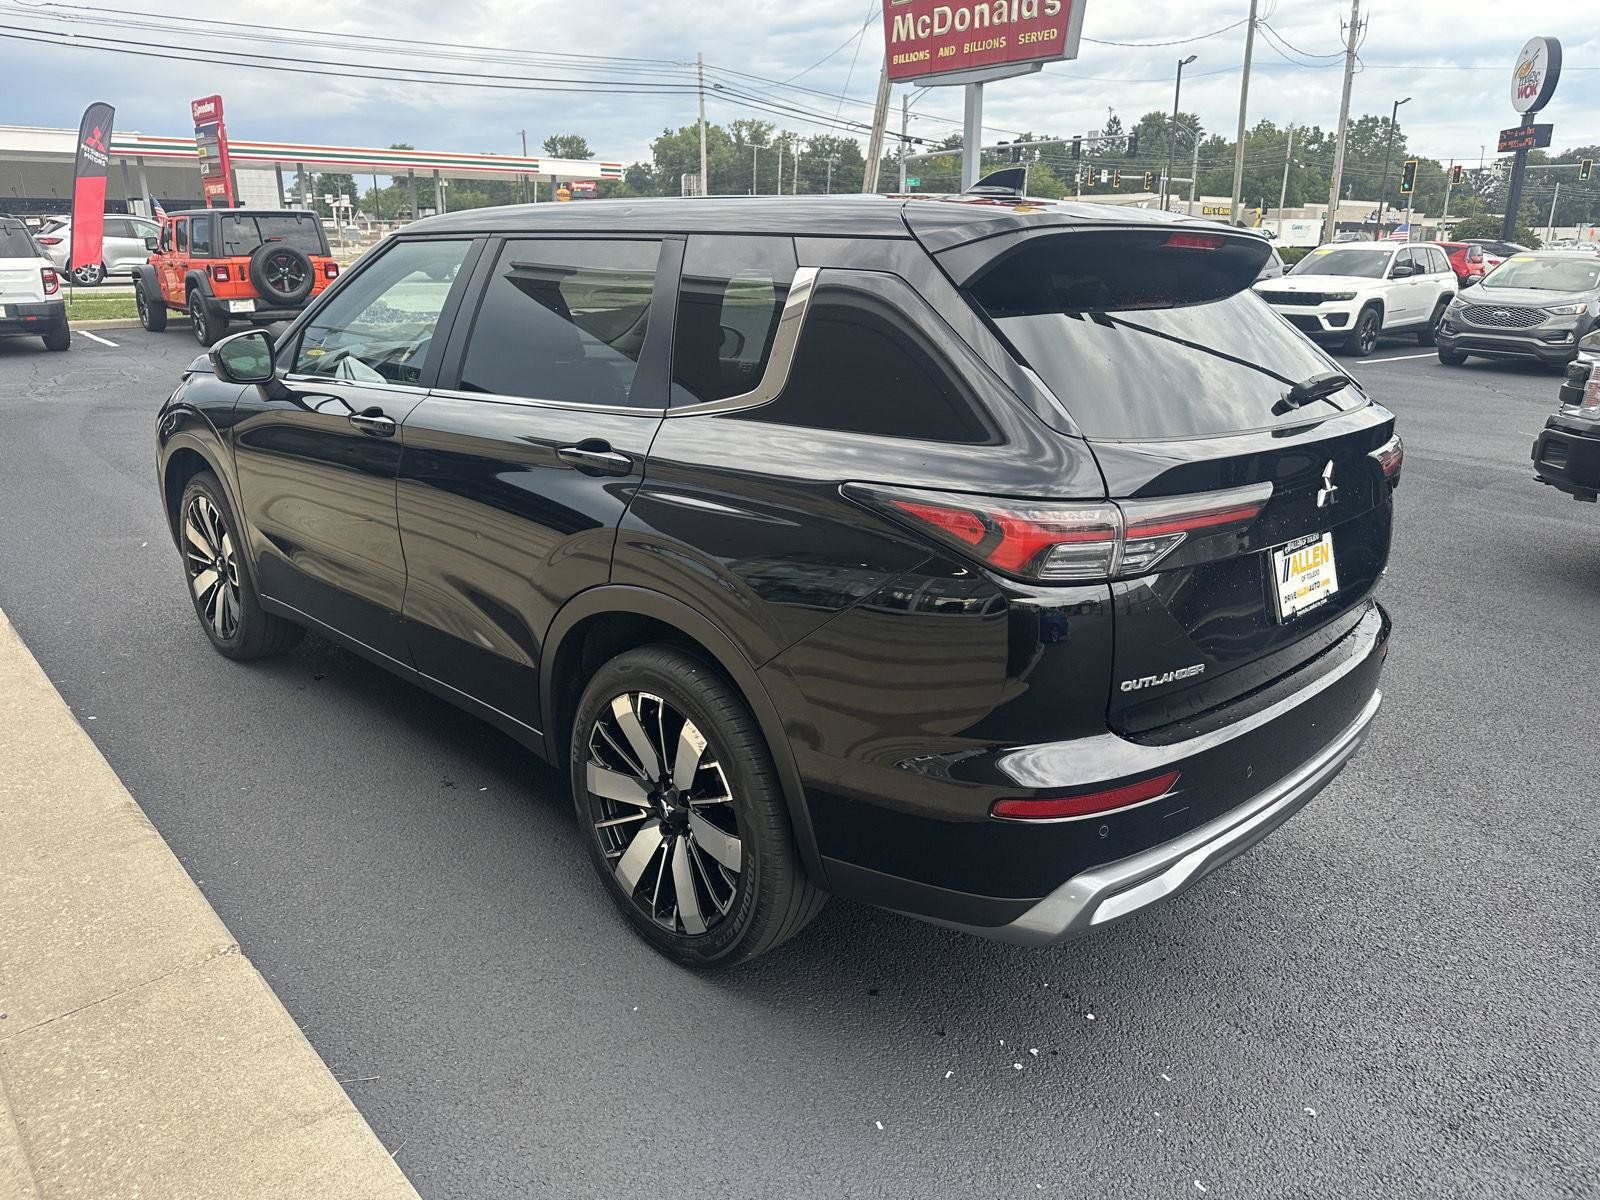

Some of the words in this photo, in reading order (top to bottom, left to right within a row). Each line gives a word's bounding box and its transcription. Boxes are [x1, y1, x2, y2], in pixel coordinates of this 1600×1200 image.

[891, 0, 1062, 44] McDonalds
[892, 49, 930, 65] BILLIONS
[937, 45, 957, 58] AND
[963, 36, 1007, 54] BILLIONS
[1018, 28, 1058, 45] SERVED
[84, 151, 106, 167] MOTORS
[1291, 542, 1329, 577] ALLEN
[1120, 663, 1206, 692] OUTLANDER
